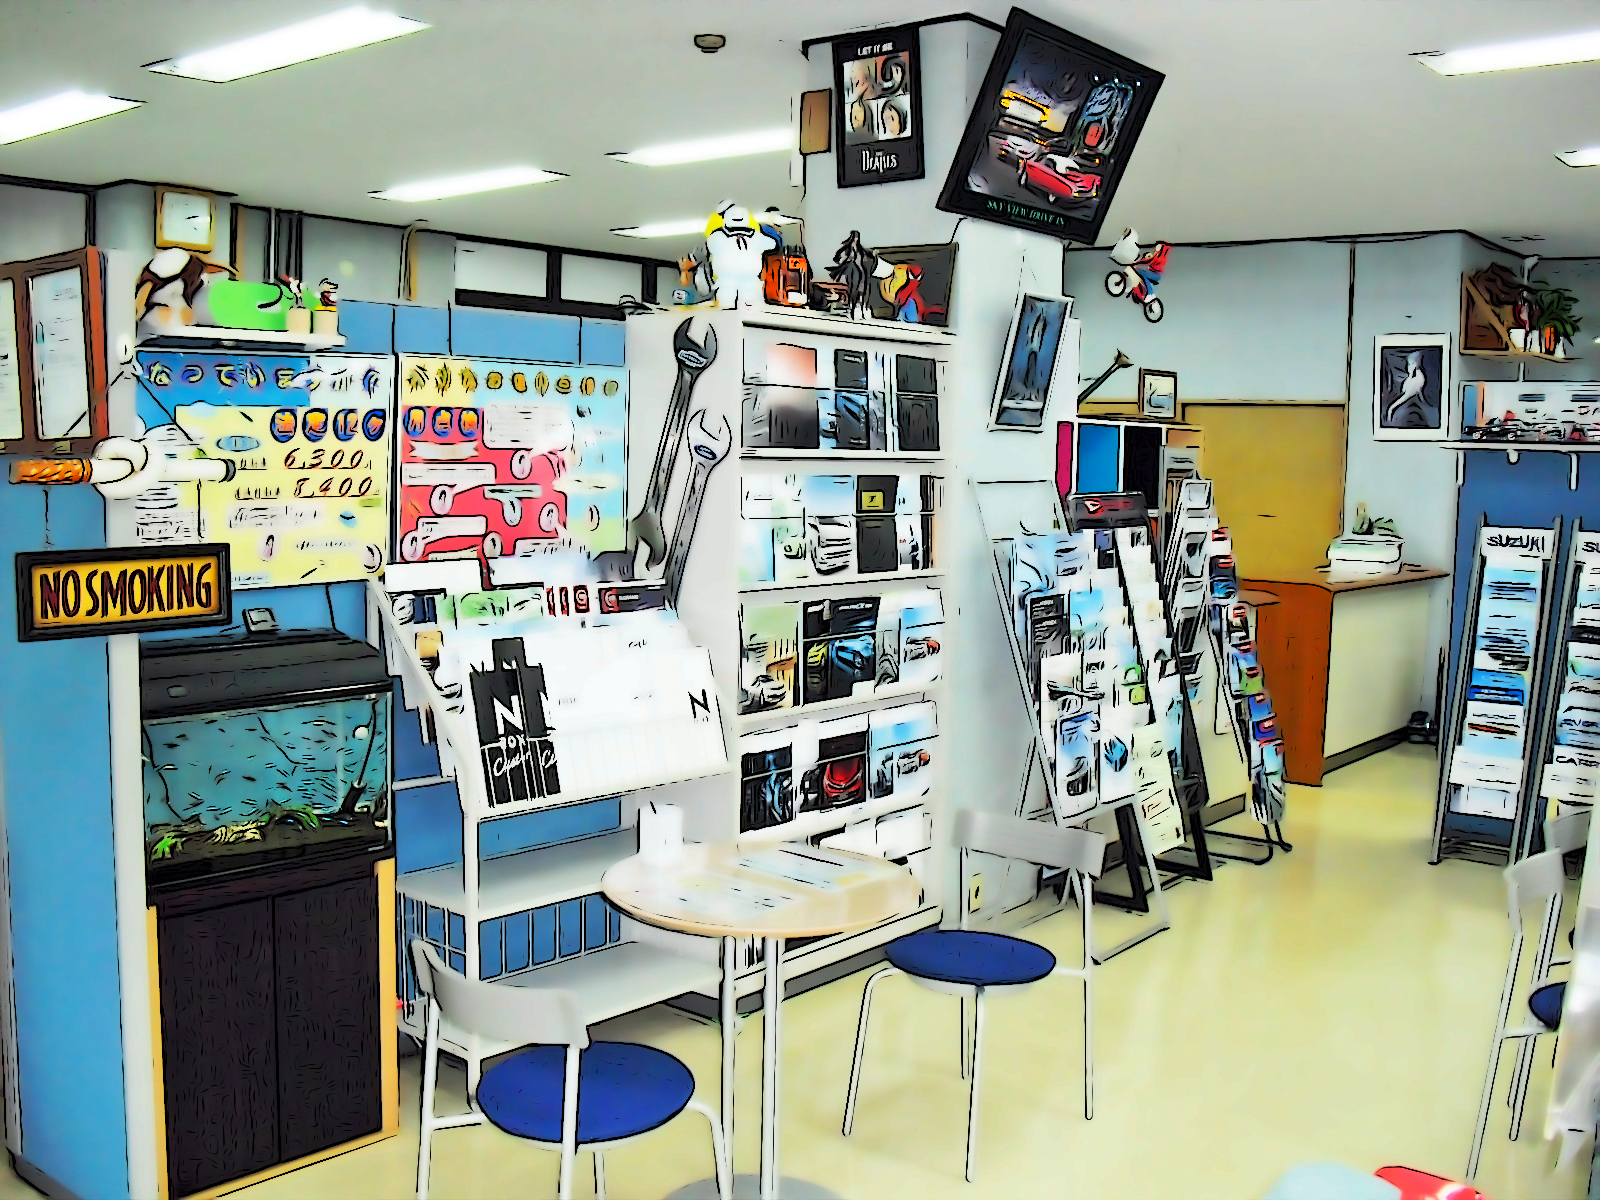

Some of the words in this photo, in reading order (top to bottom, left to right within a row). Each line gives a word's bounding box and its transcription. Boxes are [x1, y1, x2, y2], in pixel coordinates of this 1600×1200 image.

[1486, 533, 1545, 553] SUZUKI
[39, 569, 81, 620] NO
[84, 562, 212, 619] SMOKING
